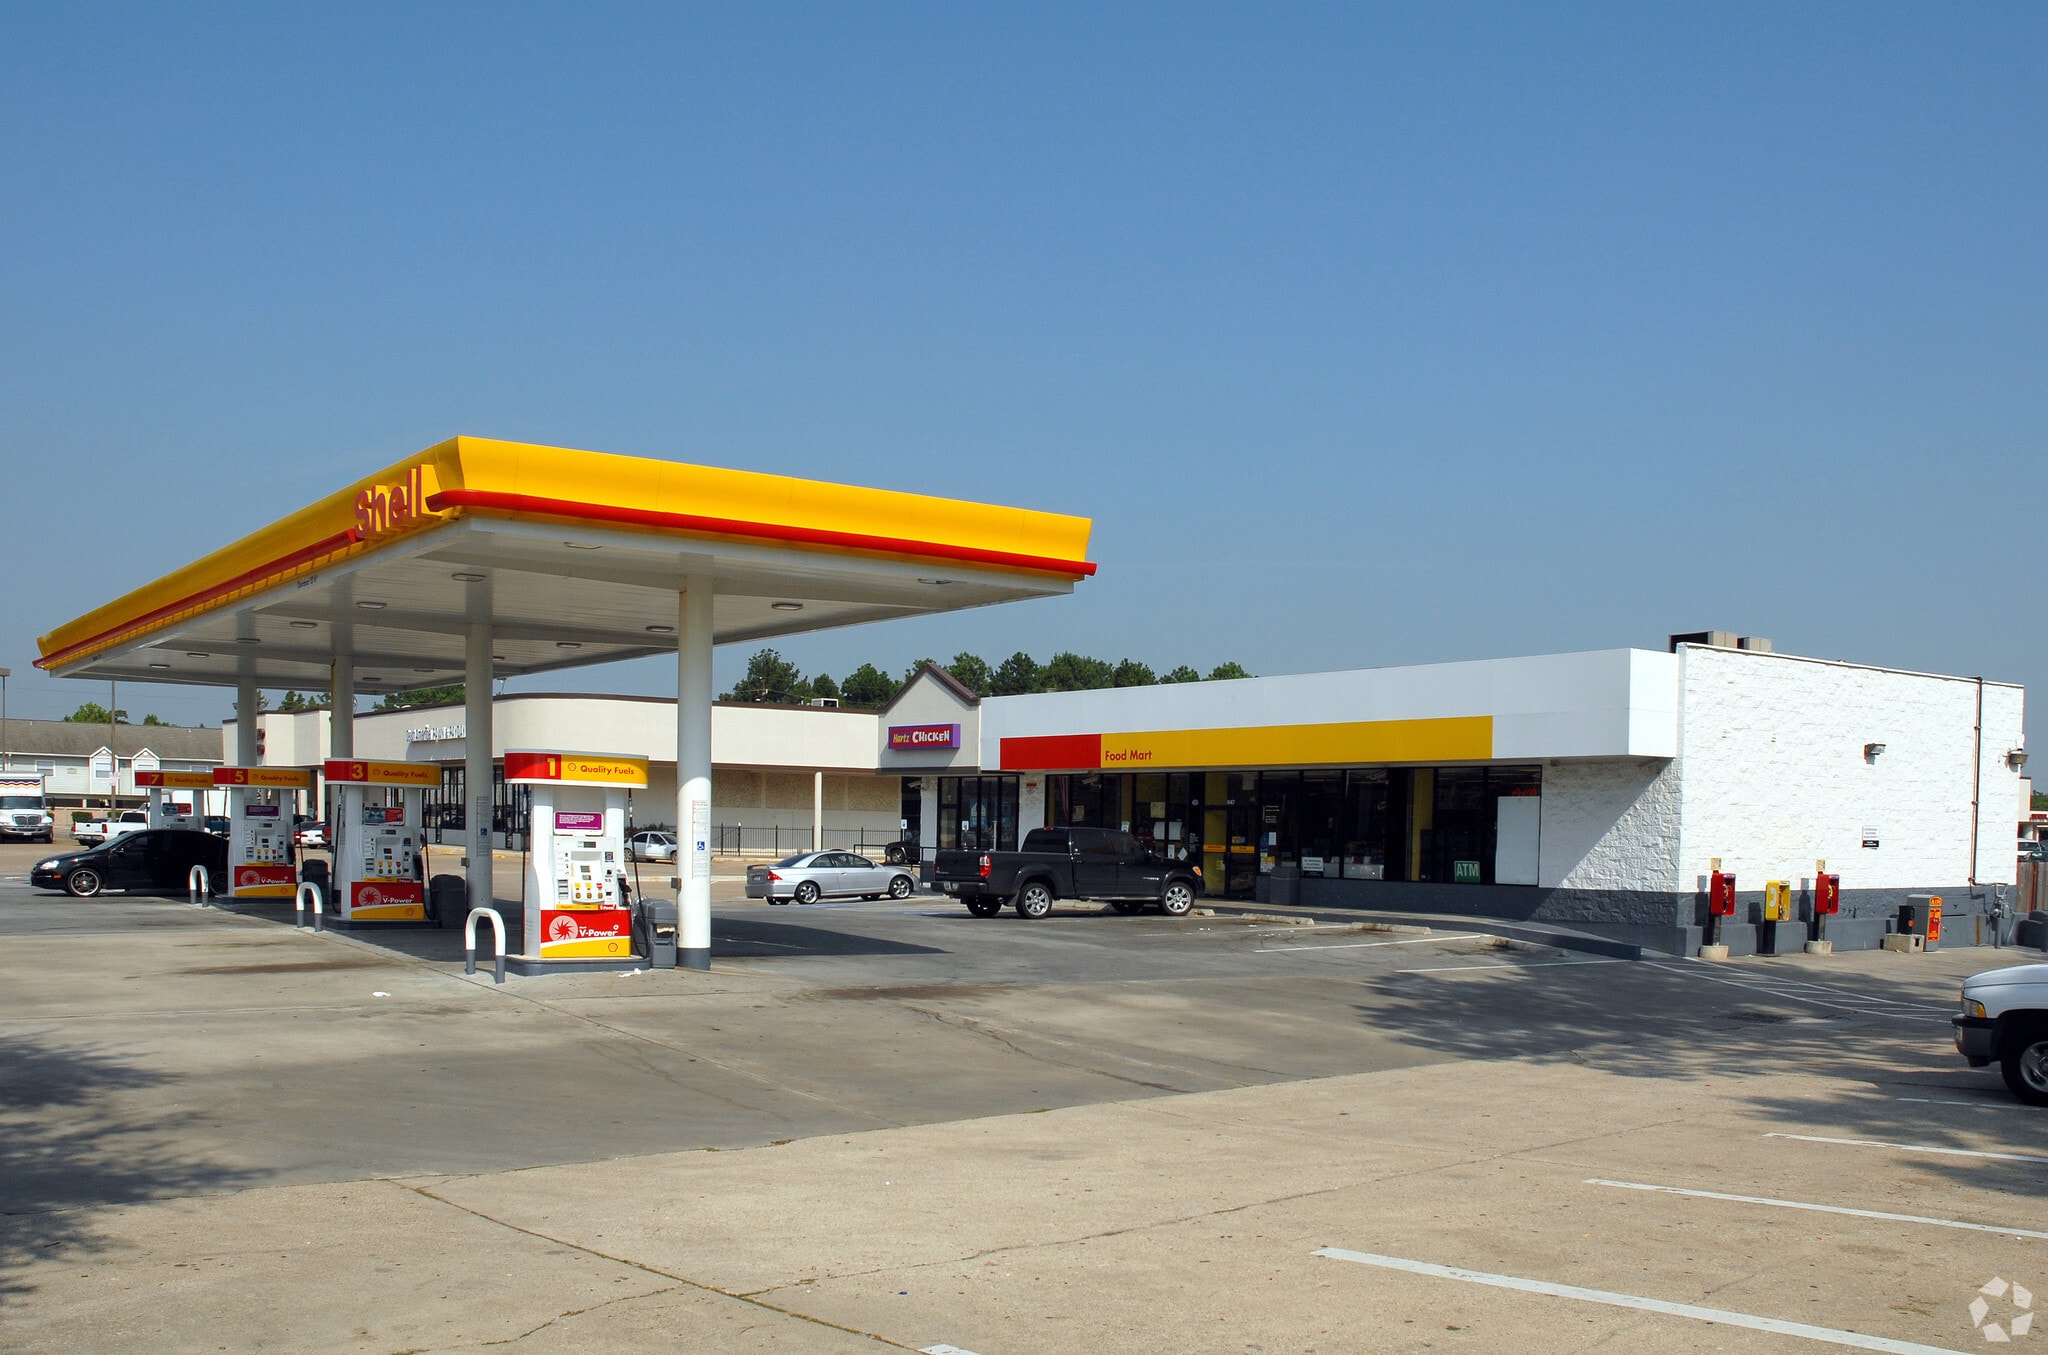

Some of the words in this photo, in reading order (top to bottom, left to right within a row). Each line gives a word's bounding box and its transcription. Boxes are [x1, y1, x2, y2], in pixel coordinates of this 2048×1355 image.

[354, 464, 438, 539] Shell
[893, 733, 910, 743] Hartz
[912, 730, 950, 743] CHICKEN
[1105, 749, 1127, 761] Food
[1129, 749, 1152, 761] Mart
[351, 763, 364, 780] 3
[383, 769, 409, 779] Quality
[547, 757, 556, 777] 1
[580, 764, 612, 775] Quality
[614, 766, 635, 775] Fuels
[151, 773, 160, 785] 7
[234, 770, 245, 783] 5
[260, 774, 282, 783] Quality
[284, 774, 299, 782] Fuels
[1456, 863, 1479, 877] ATM
[579, 929, 618, 937] V-Power
